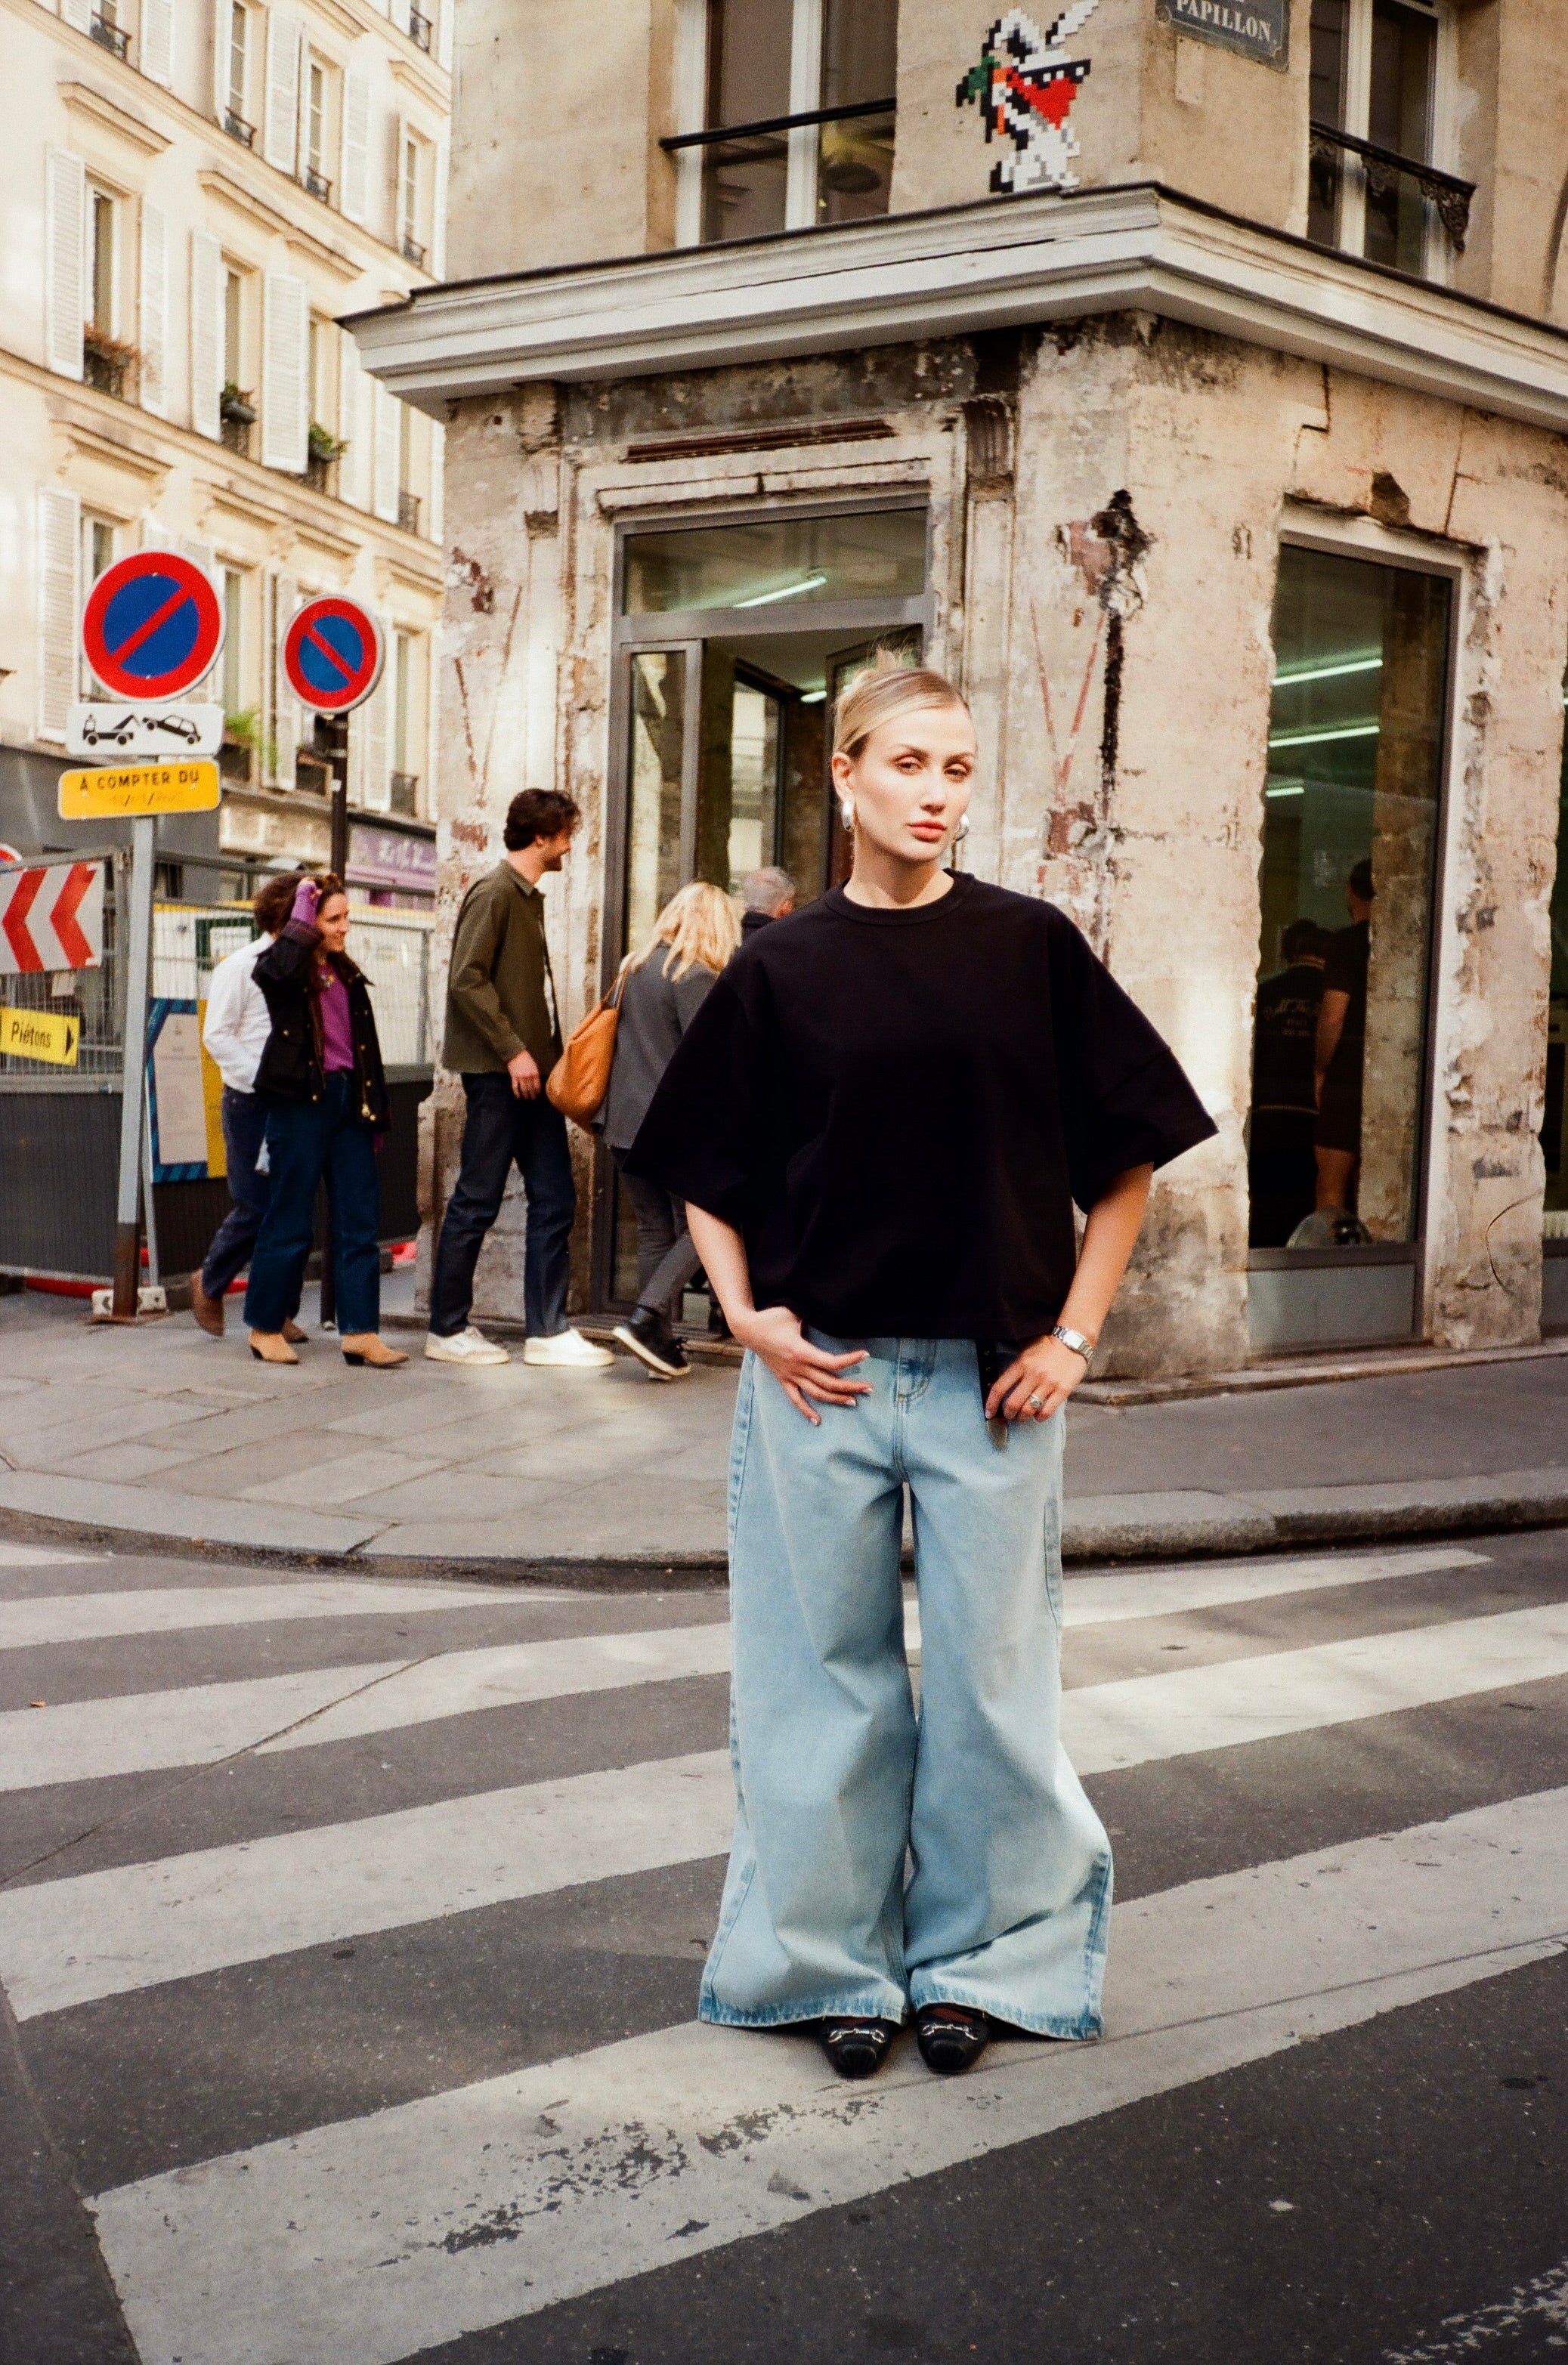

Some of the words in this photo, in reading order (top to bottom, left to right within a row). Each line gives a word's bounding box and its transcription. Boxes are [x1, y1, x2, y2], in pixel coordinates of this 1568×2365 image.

[1177, 0, 1271, 42] PAPILLON
[97, 771, 170, 790] COMPTER
[178, 769, 199, 783] DU
[11, 1020, 51, 1048] Piétons
